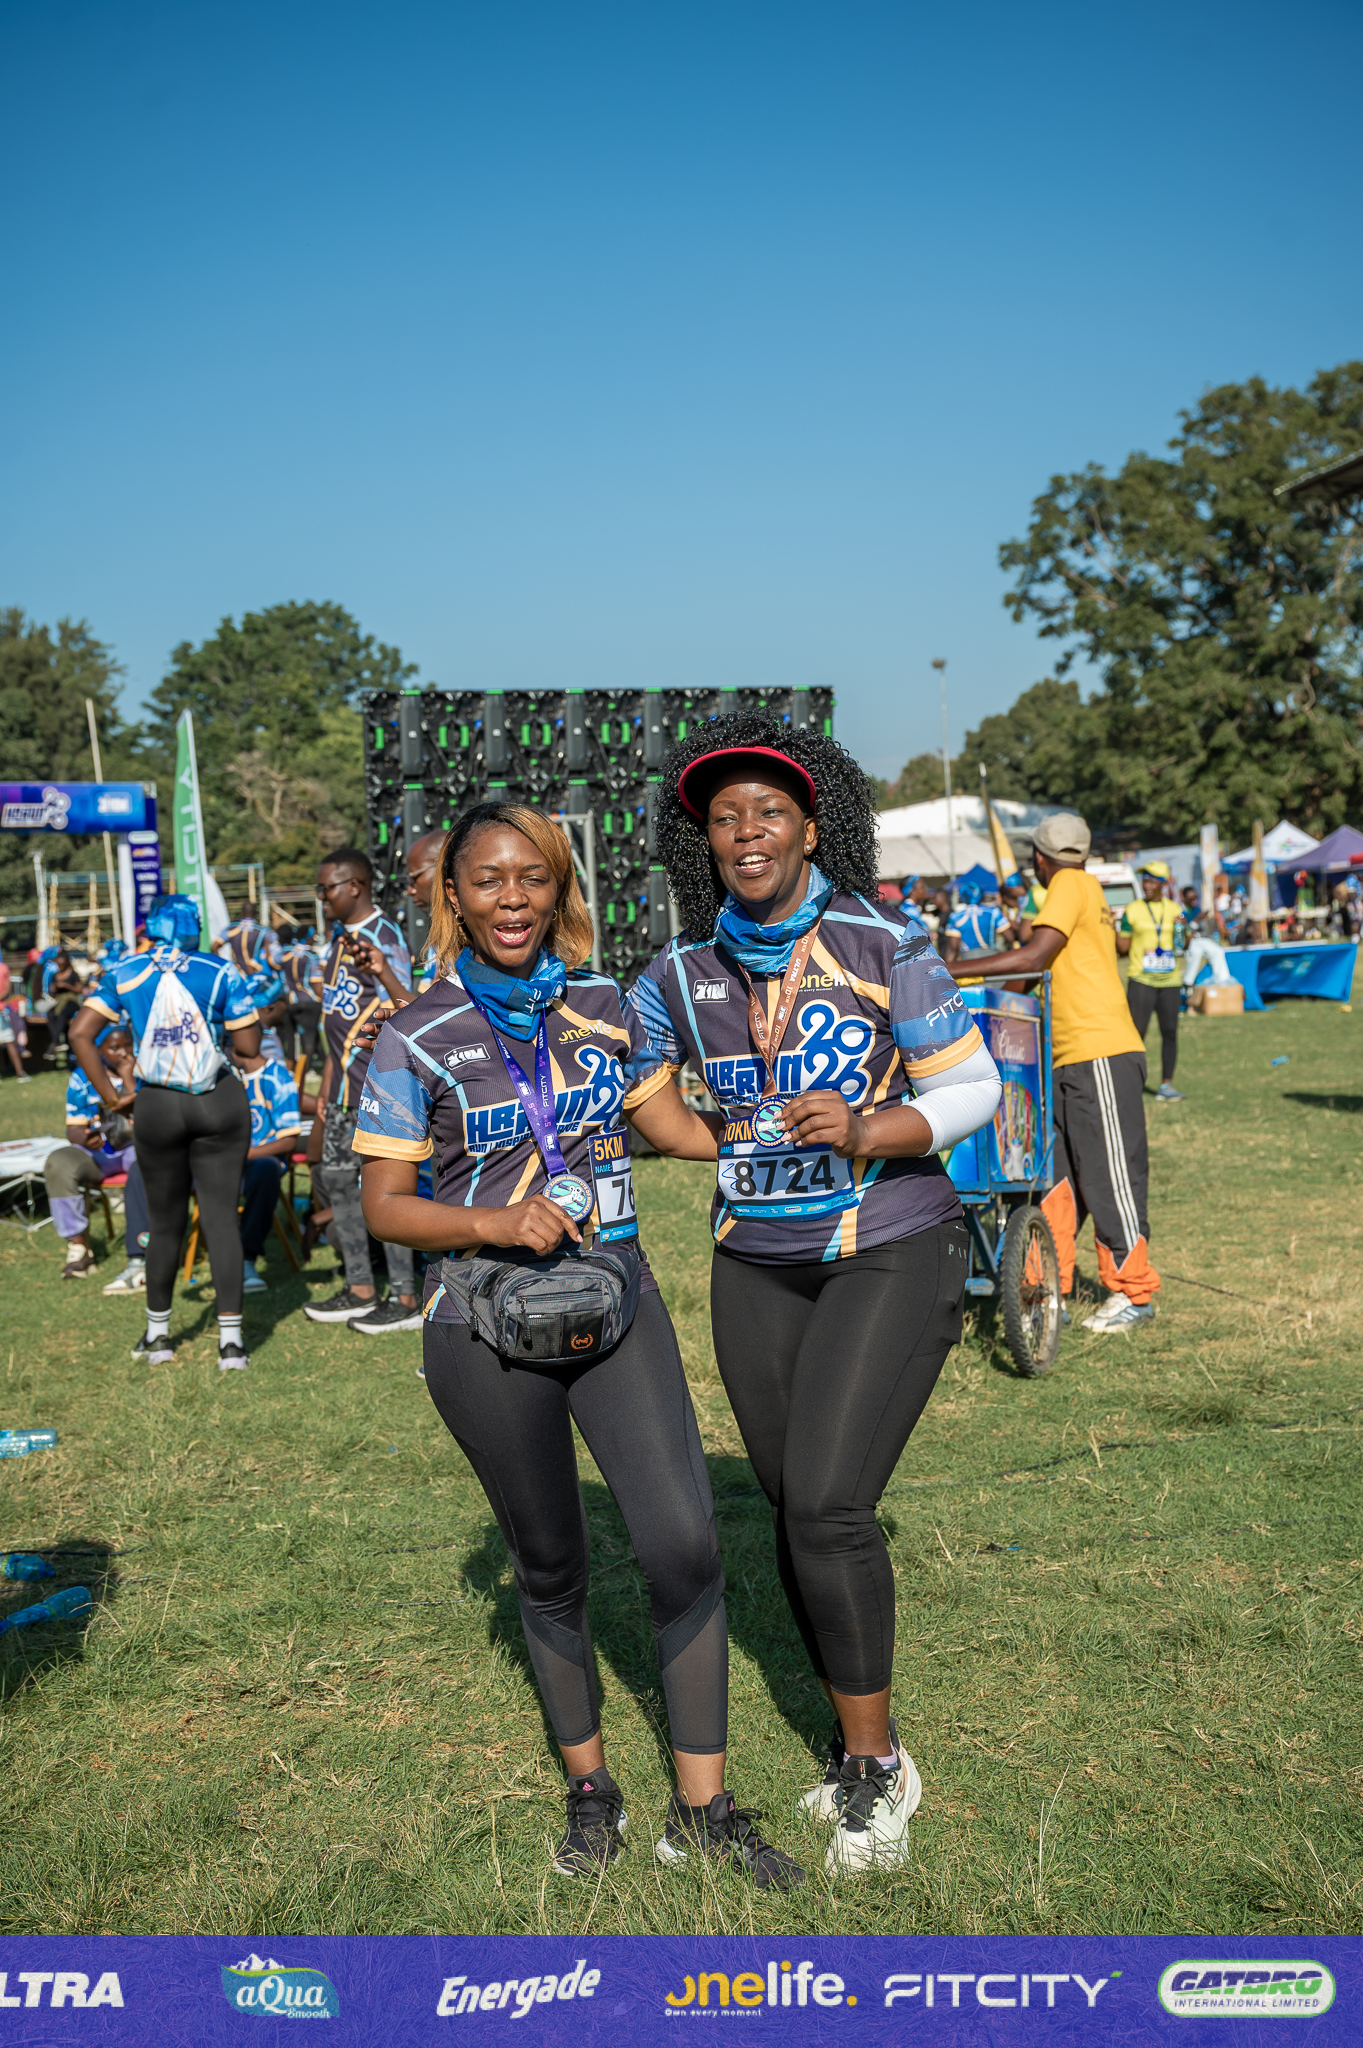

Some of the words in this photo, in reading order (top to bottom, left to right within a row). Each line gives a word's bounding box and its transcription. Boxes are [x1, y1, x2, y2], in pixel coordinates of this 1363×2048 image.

[789, 957, 802, 982] ULTRA
[753, 1011, 766, 1040] FITCITY
[540, 1074, 549, 1108] FITCITY
[594, 1135, 624, 1161] 5KM
[594, 1163, 613, 1174] NAME:
[734, 1154, 836, 1197] 8724
